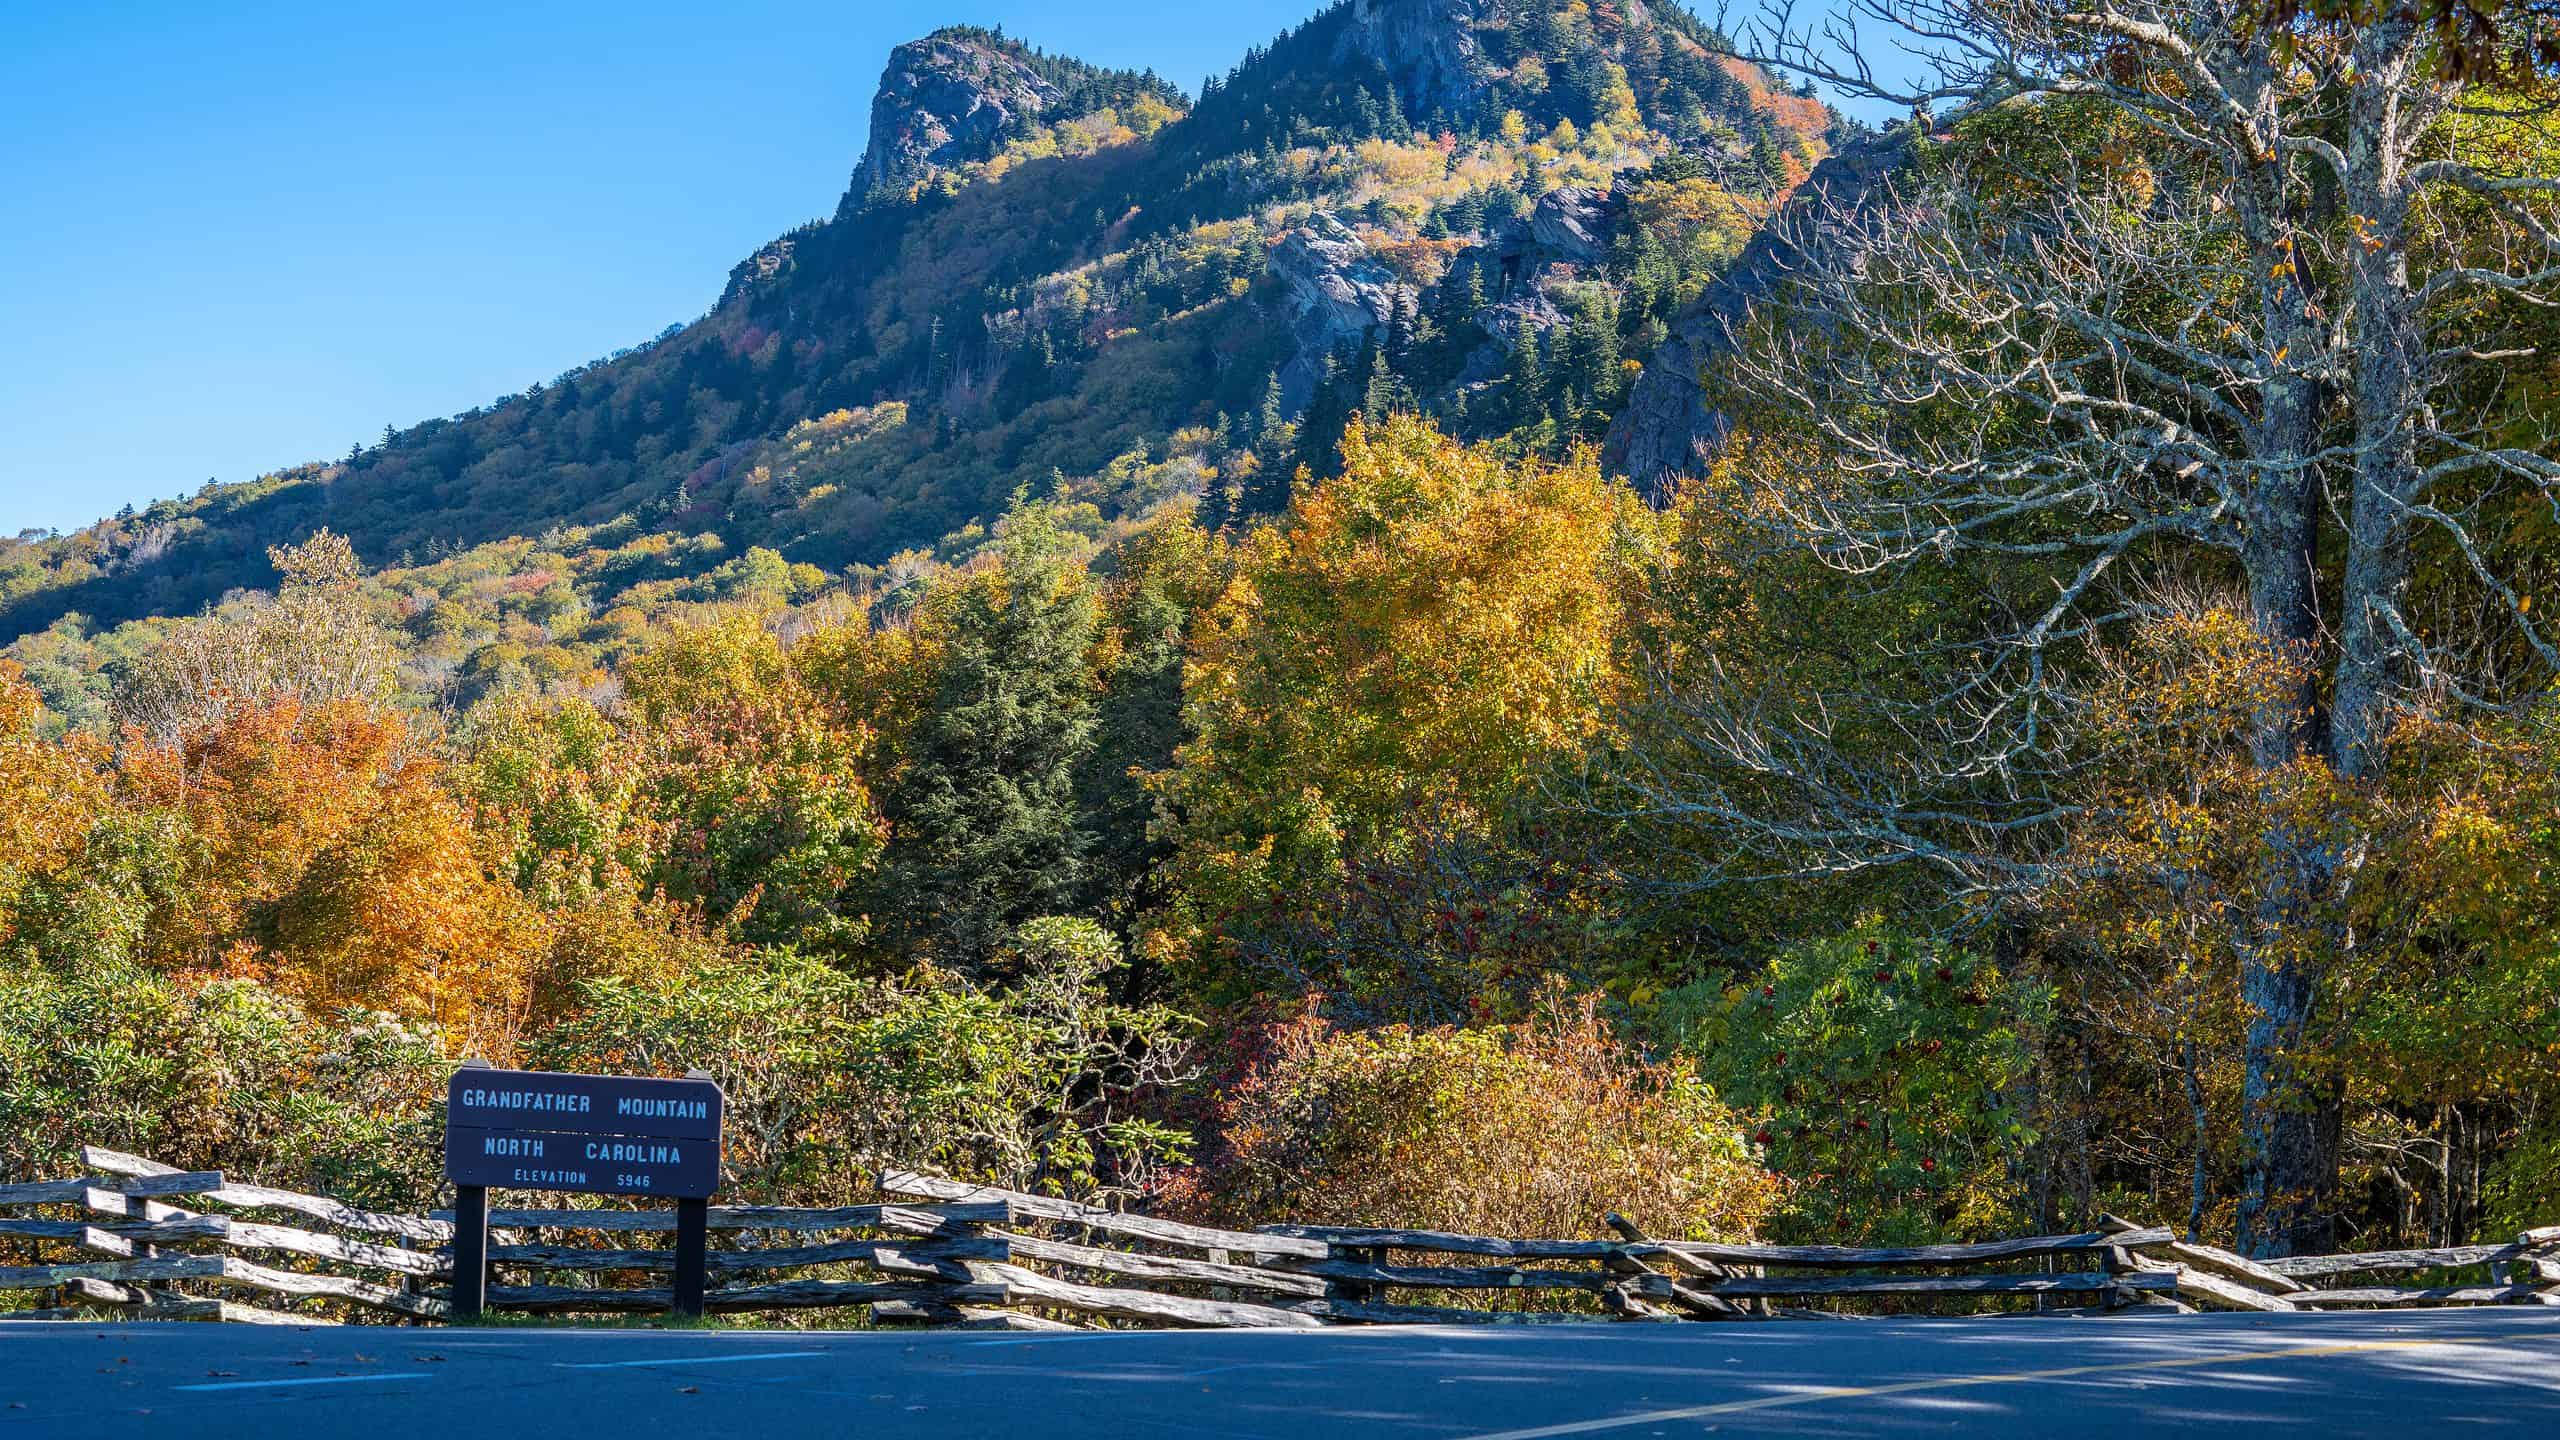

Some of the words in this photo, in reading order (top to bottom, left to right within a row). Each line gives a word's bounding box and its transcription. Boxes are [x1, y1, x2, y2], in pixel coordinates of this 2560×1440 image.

[462, 1089, 590, 1113] GRANDFATHER
[618, 1098, 707, 1119] MOUNTAIN
[484, 1138, 544, 1158] NORTH
[585, 1143, 681, 1164] CAROLINA
[514, 1169, 586, 1185] ELEVATION
[617, 1175, 650, 1188] 5946
